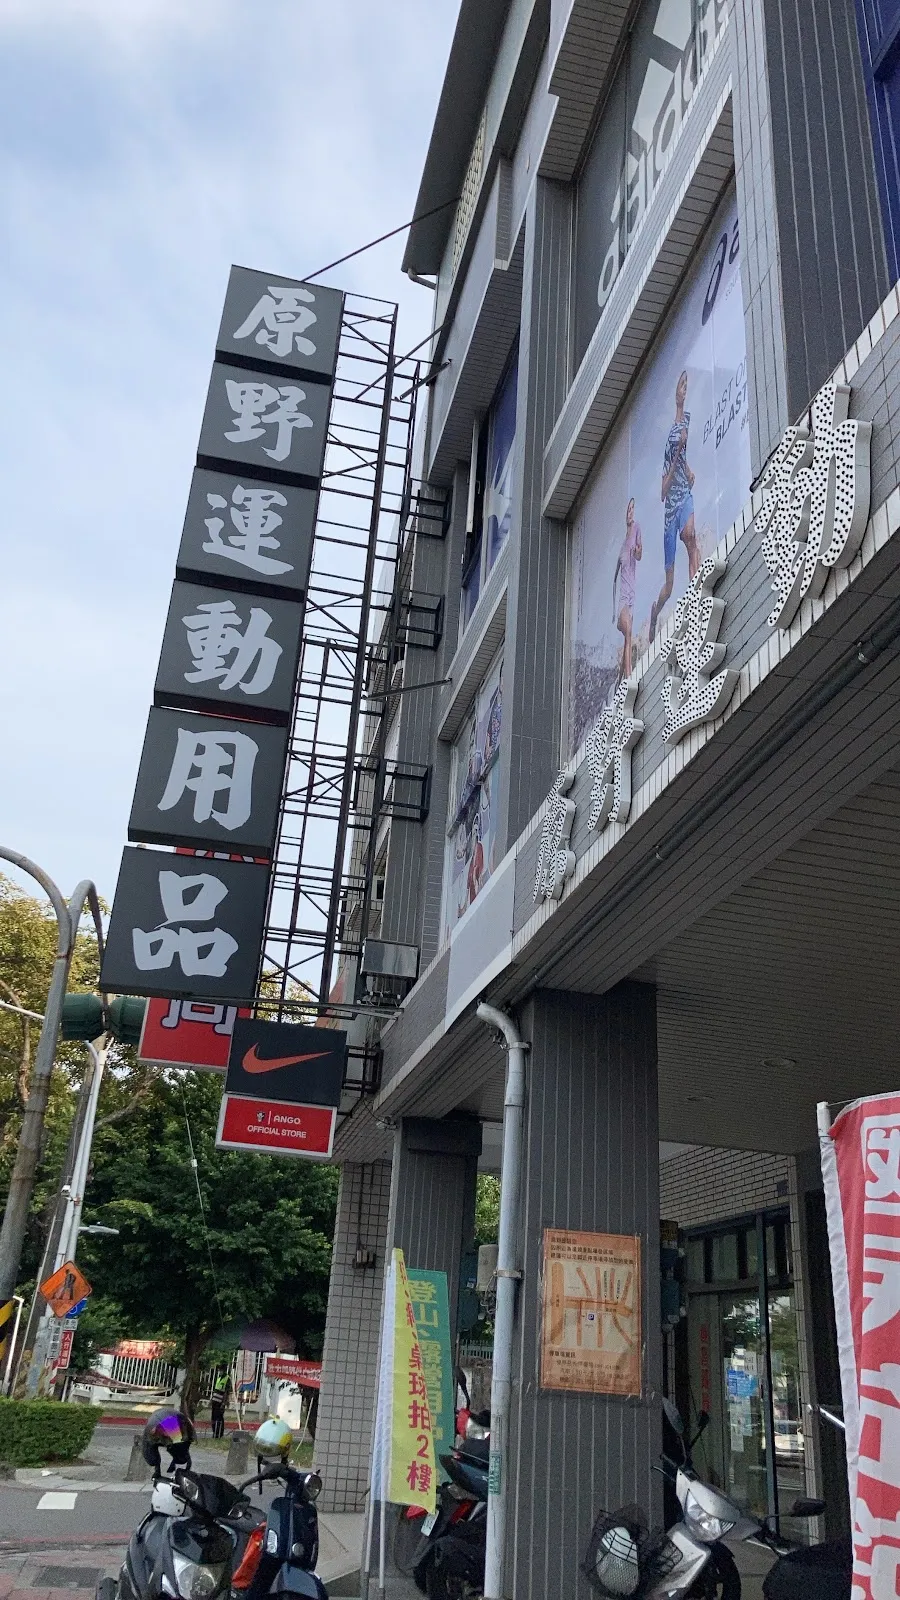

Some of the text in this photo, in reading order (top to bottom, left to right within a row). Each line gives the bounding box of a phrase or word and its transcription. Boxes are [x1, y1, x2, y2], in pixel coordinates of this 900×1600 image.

[703, 376, 734, 445] BLAST
[716, 382, 747, 449] BLAST
[132, 285, 317, 977] 原野運動用品
[533, 383, 868, 903] 原野運動
[247, 1124, 307, 1139] OFFICIAL STORE
[273, 1114, 301, 1125] ANGO
